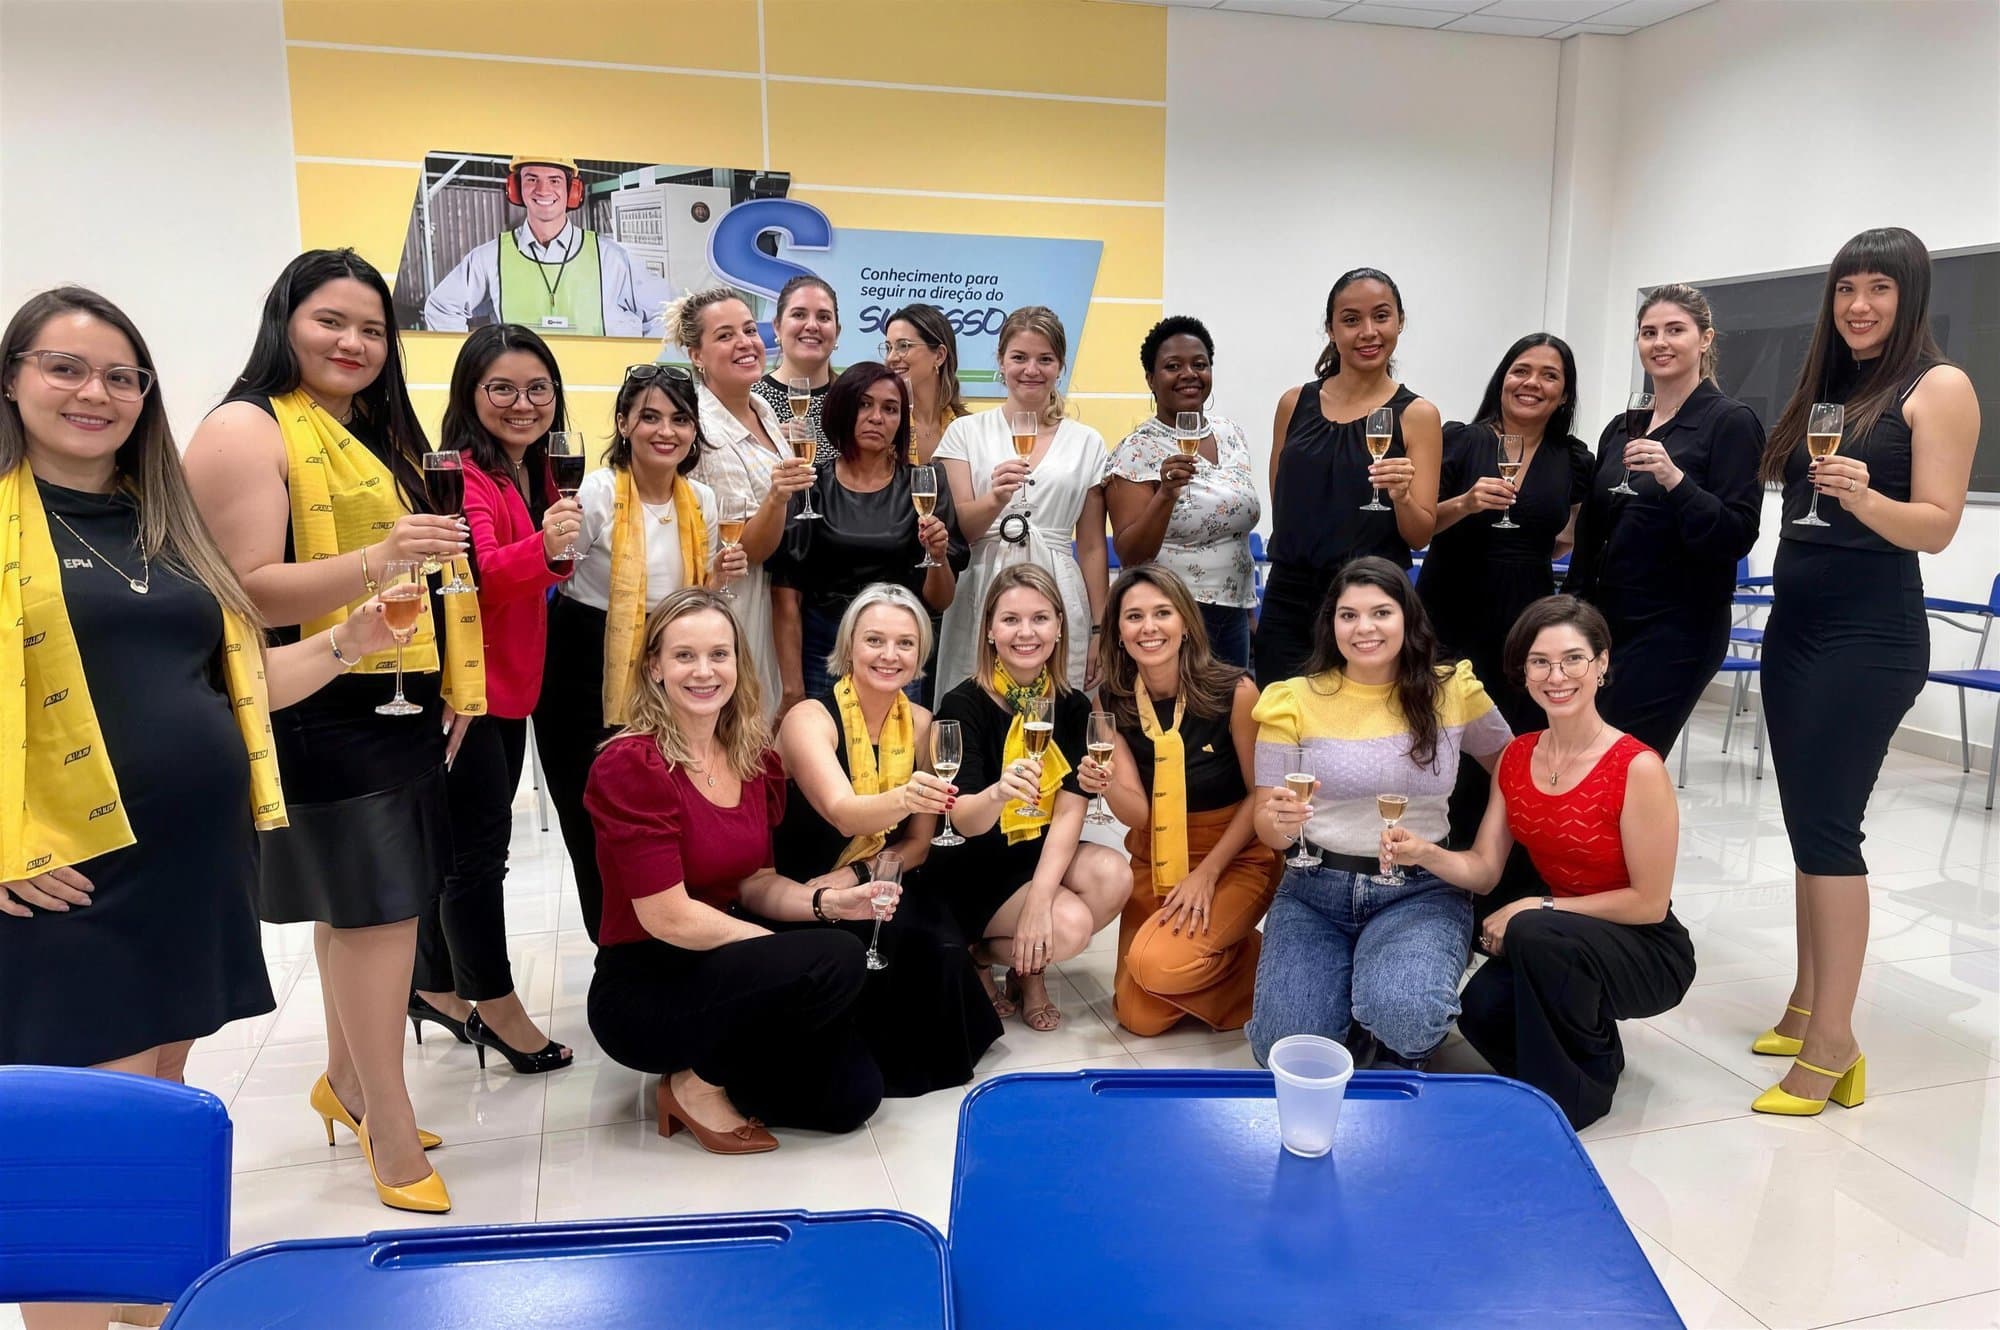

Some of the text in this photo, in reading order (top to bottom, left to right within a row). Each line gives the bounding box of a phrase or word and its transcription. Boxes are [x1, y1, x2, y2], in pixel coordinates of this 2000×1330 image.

[860, 267, 999, 287] Conhecimento para
[860, 284, 1004, 303] seguir na direção do
[858, 305, 1008, 337] SUSSO
